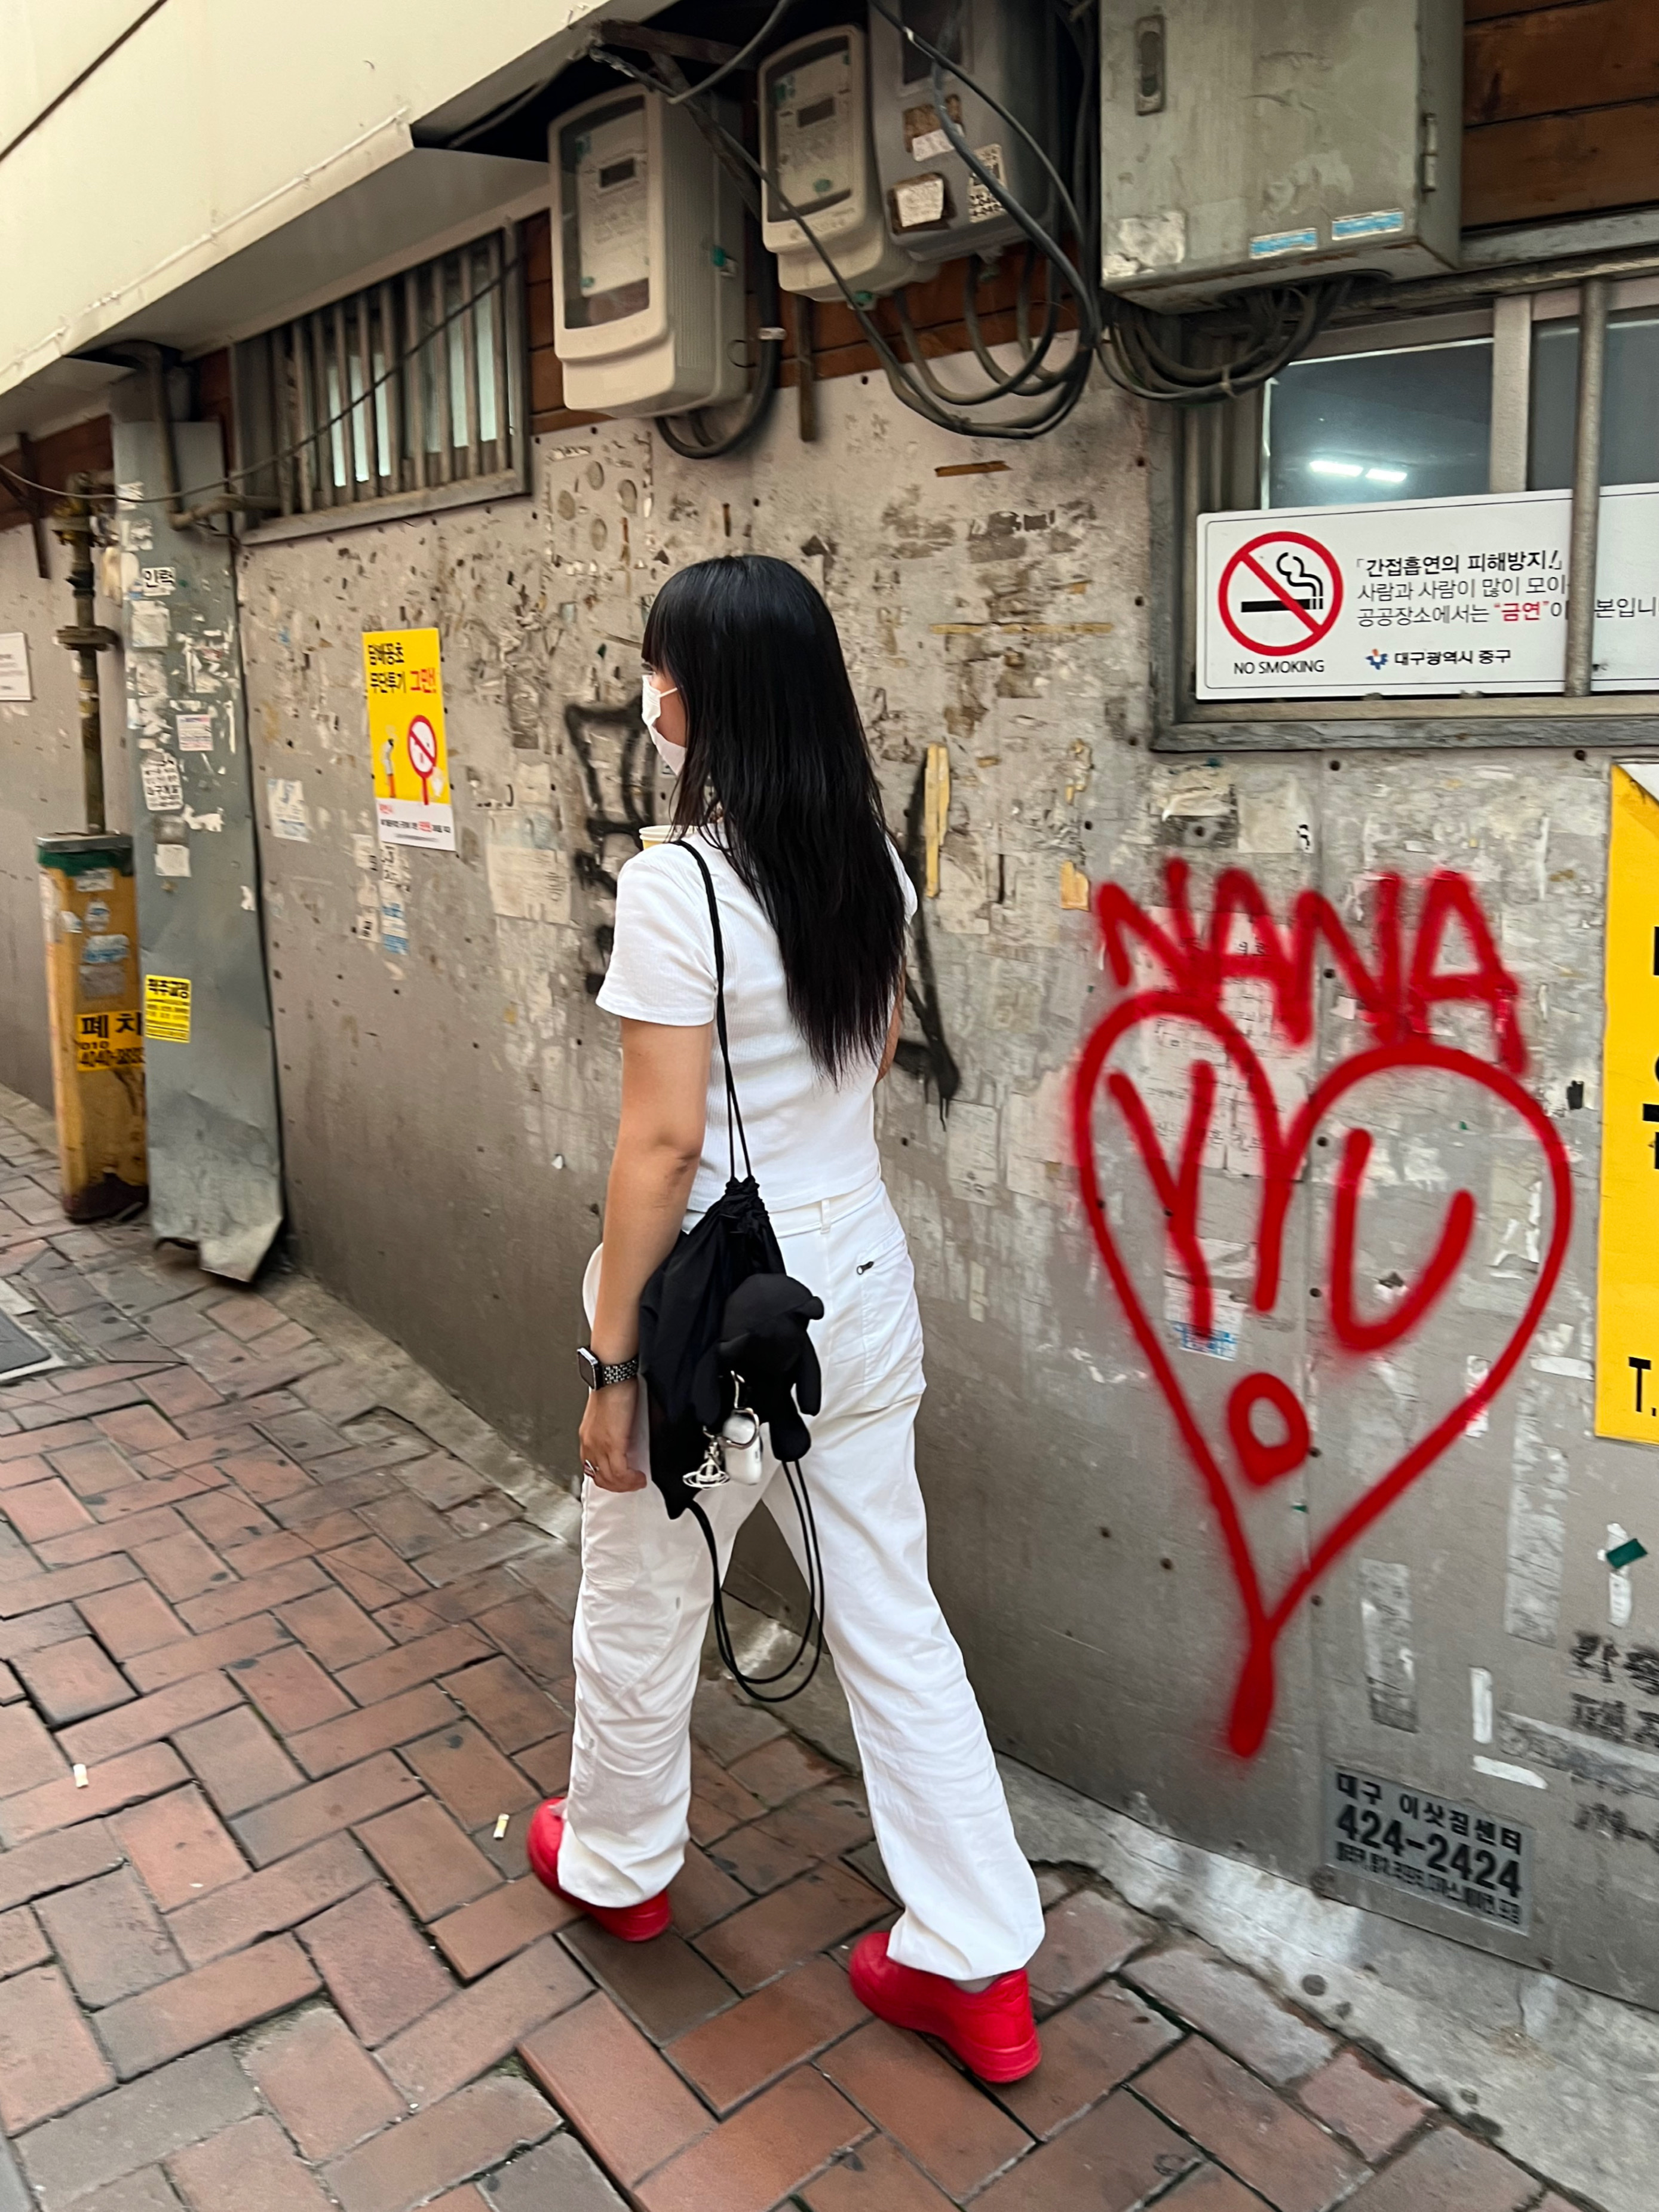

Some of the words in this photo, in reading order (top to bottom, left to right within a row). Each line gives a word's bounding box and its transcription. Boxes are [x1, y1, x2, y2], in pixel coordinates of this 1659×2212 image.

[1357, 582, 1414, 602] 사람과
[1418, 579, 1475, 600] 사람이
[1482, 576, 1520, 597] 많이
[1525, 574, 1569, 595] 모이
[1357, 604, 1490, 627] 공공장소에서는
[1593, 597, 1659, 618] 본입니
[1234, 662, 1256, 674] NO
[1258, 659, 1325, 674] SMOKING
[1394, 650, 1473, 665] 대구광역시
[1479, 650, 1511, 664] 중구
[1094, 855, 1527, 1076] NANA
[1336, 1772, 1382, 1806] 대구
[1399, 1793, 1522, 1856] 이삿짐센터
[1336, 1803, 1522, 1899] 424-2424
